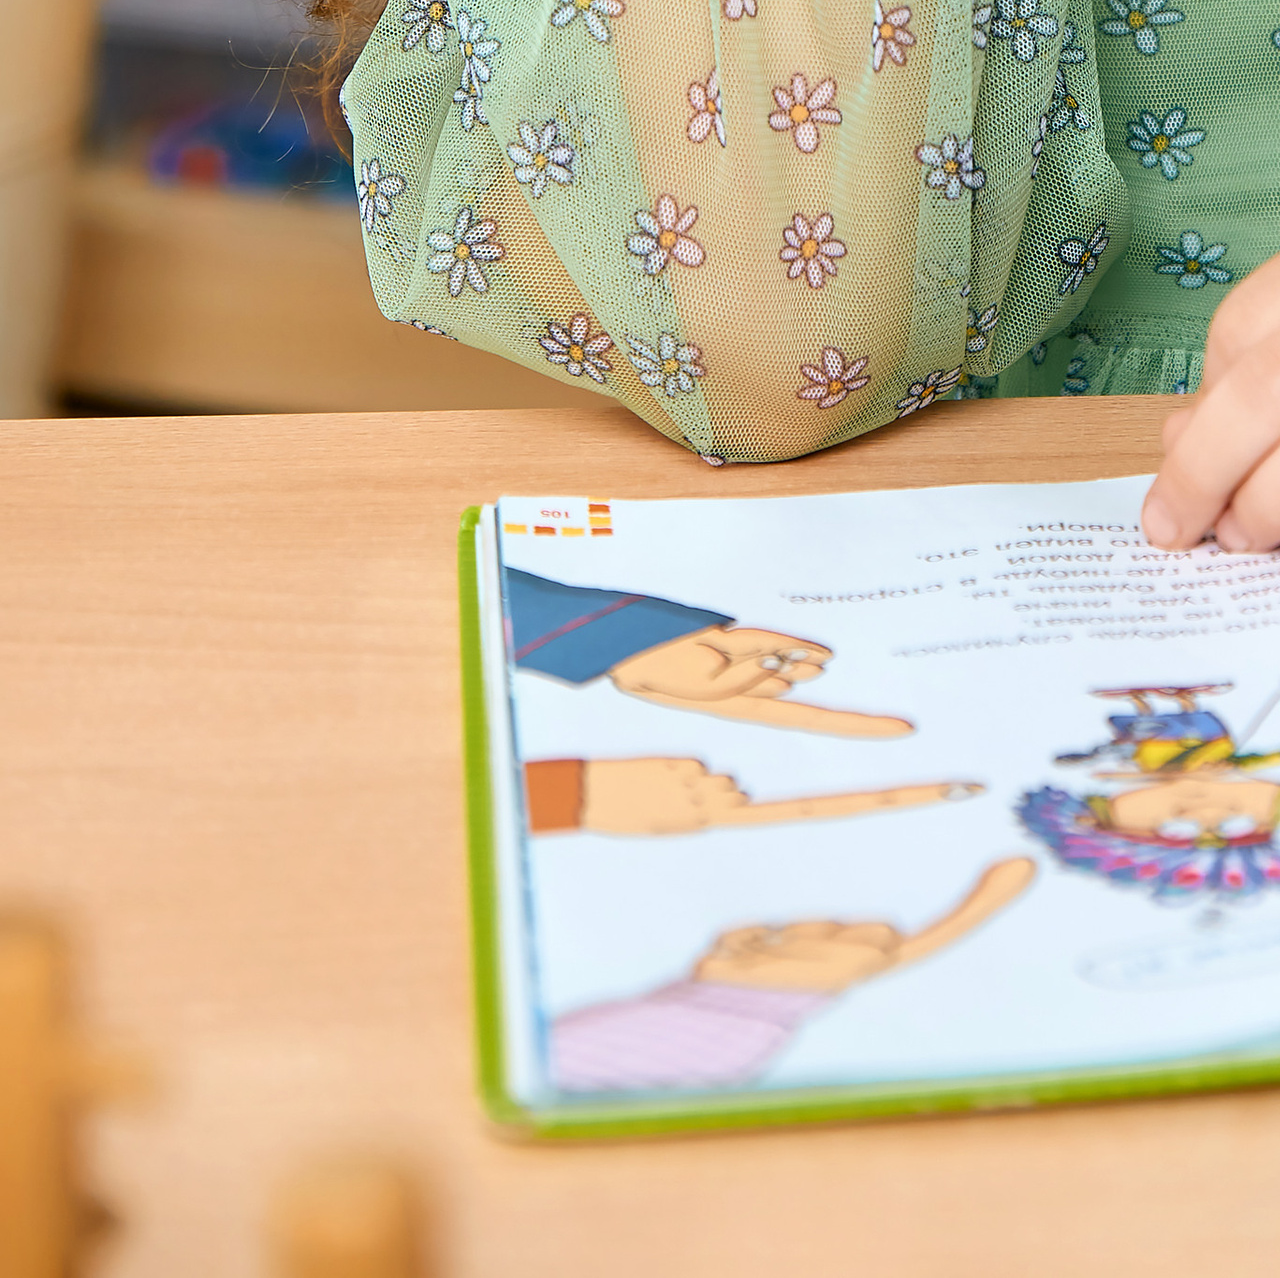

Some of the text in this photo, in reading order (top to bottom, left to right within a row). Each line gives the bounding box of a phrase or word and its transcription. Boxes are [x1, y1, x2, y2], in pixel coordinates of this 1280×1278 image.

[539, 510, 571, 519] 105
[1017, 522, 1139, 534] говори.
[994, 537, 1094, 552] видел
[1006, 552, 1193, 567] иди домой
[993, 567, 1180, 581] где-нибудь
[959, 577, 977, 587] в
[1029, 583, 1155, 597] будешь
[1013, 601, 1112, 614] иначе
[1183, 610, 1224, 622] не
[1087, 619, 1280, 642] что-нибудь
